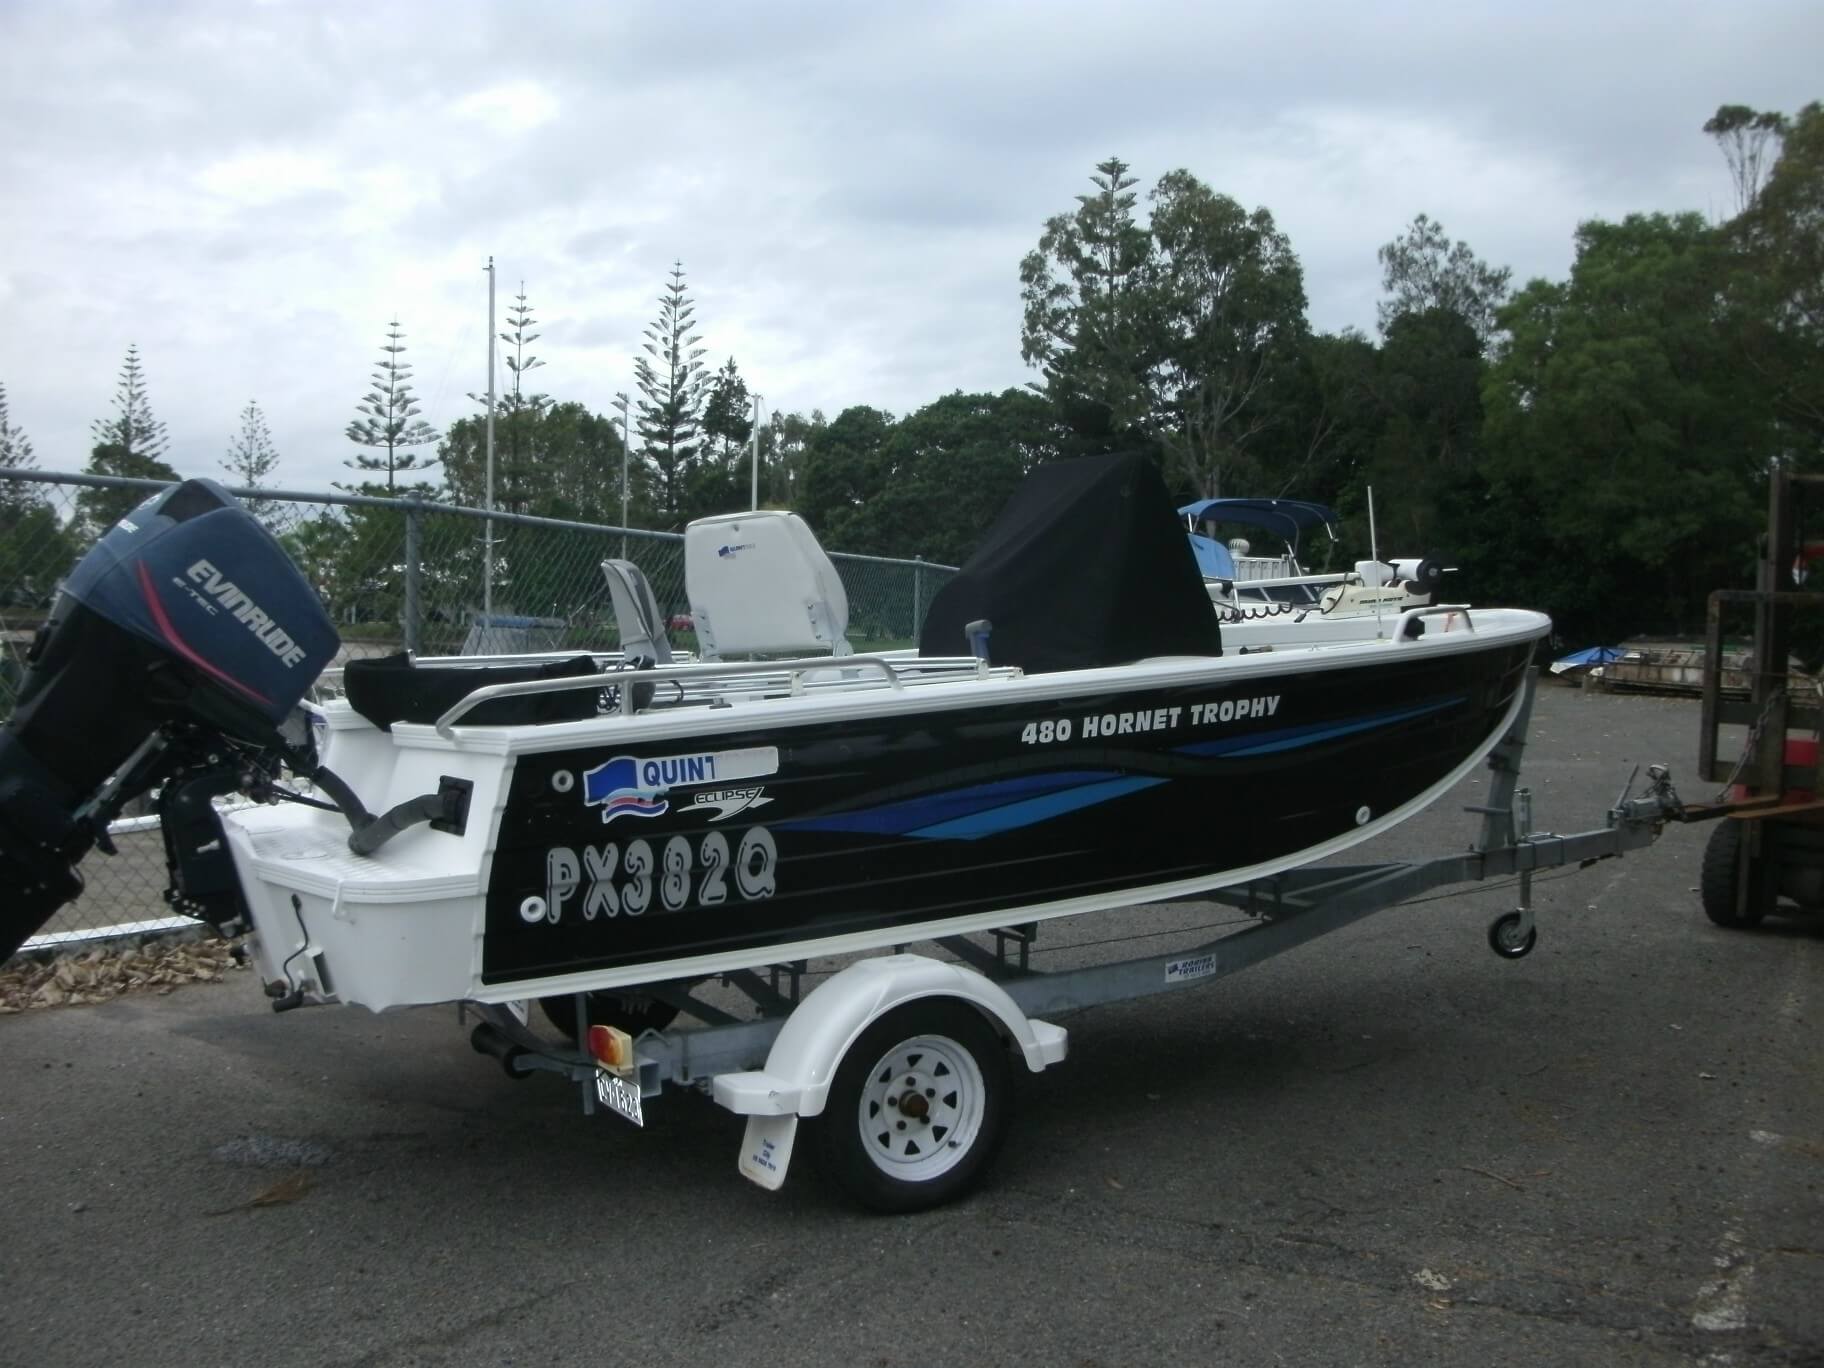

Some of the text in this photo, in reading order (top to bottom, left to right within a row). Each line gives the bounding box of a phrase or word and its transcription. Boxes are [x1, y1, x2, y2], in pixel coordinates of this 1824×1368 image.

[187, 559, 307, 669] EVINRUDE
[1021, 695, 1280, 745] 480 HORNET TROPHY
[694, 787, 758, 804] ECLIPSE
[546, 826, 777, 924] PX382Q
